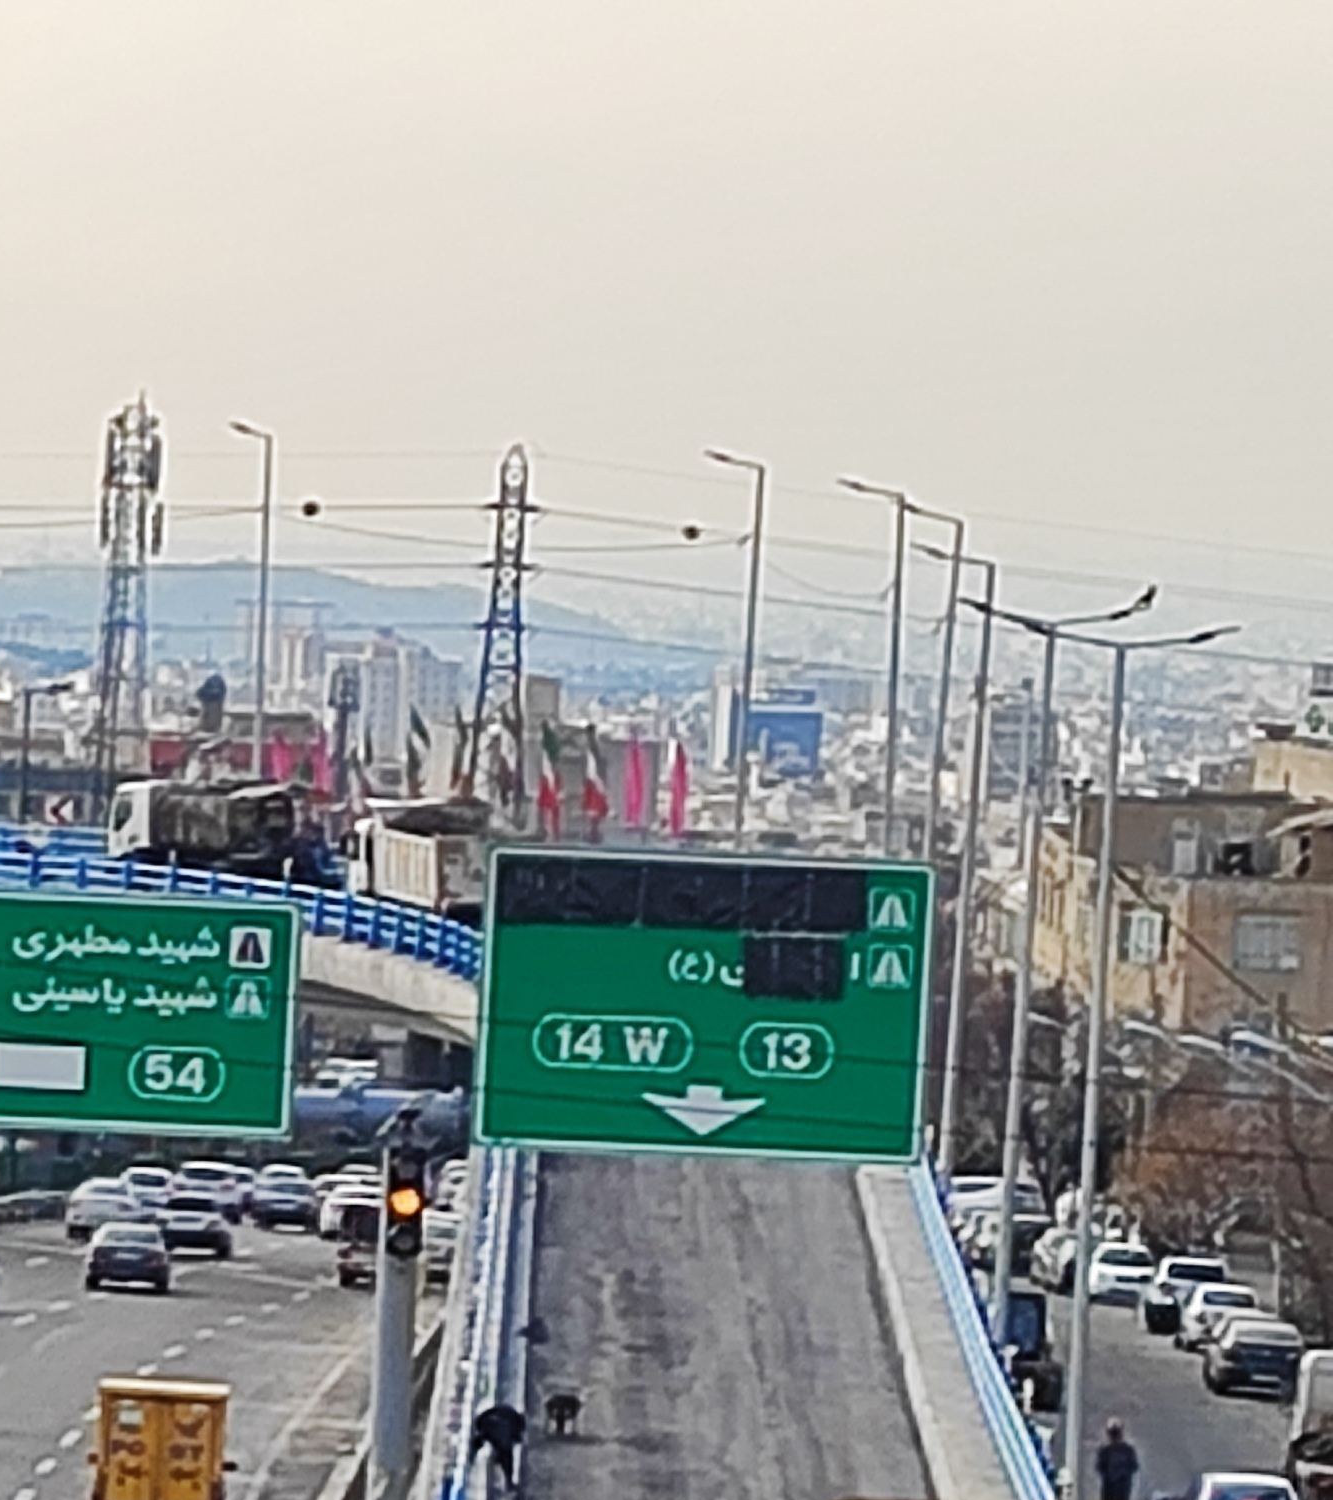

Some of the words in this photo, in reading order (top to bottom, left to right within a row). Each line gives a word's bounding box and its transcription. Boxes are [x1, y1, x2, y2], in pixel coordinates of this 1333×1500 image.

[12, 925, 131, 962] مطهری
[136, 926, 221, 965] شهید
[12, 977, 127, 1014] یاسینی
[132, 976, 218, 1018] شهید
[556, 1023, 603, 1061] 14
[623, 1025, 669, 1065] W
[762, 1032, 812, 1071] 13
[143, 1053, 206, 1095] 54
